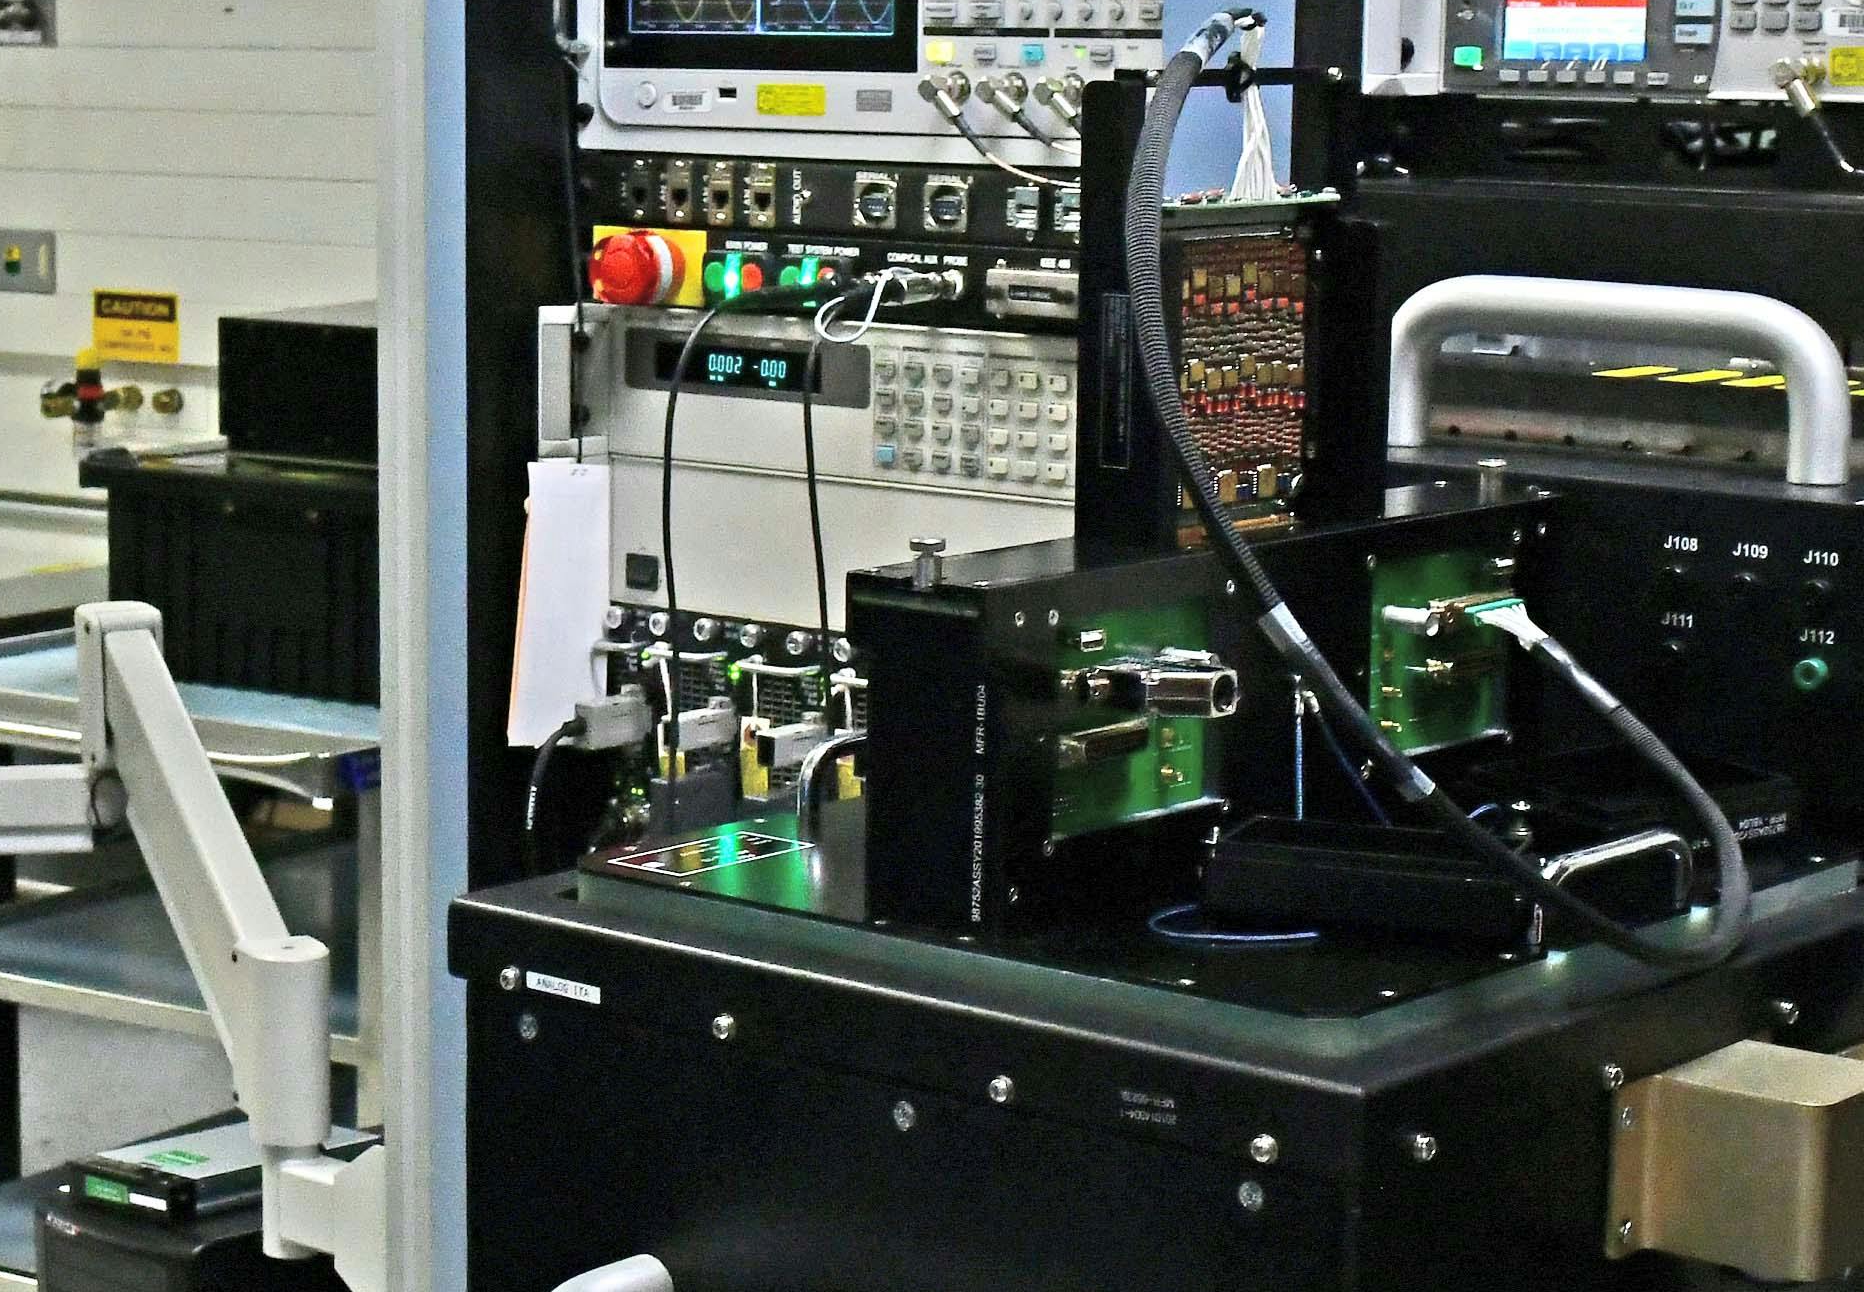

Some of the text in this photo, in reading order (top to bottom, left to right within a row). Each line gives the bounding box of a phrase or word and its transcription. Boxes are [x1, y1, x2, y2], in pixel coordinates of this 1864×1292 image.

[792, 169, 802, 190] OUT
[834, 246, 860, 258] POWER
[1664, 534, 1699, 553] J108
[1732, 542, 1769, 560] J109
[1803, 549, 1840, 568] J110
[1661, 611, 1694, 629] J111
[1800, 628, 1836, 646] J112
[537, 977, 569, 995] ANALOG
